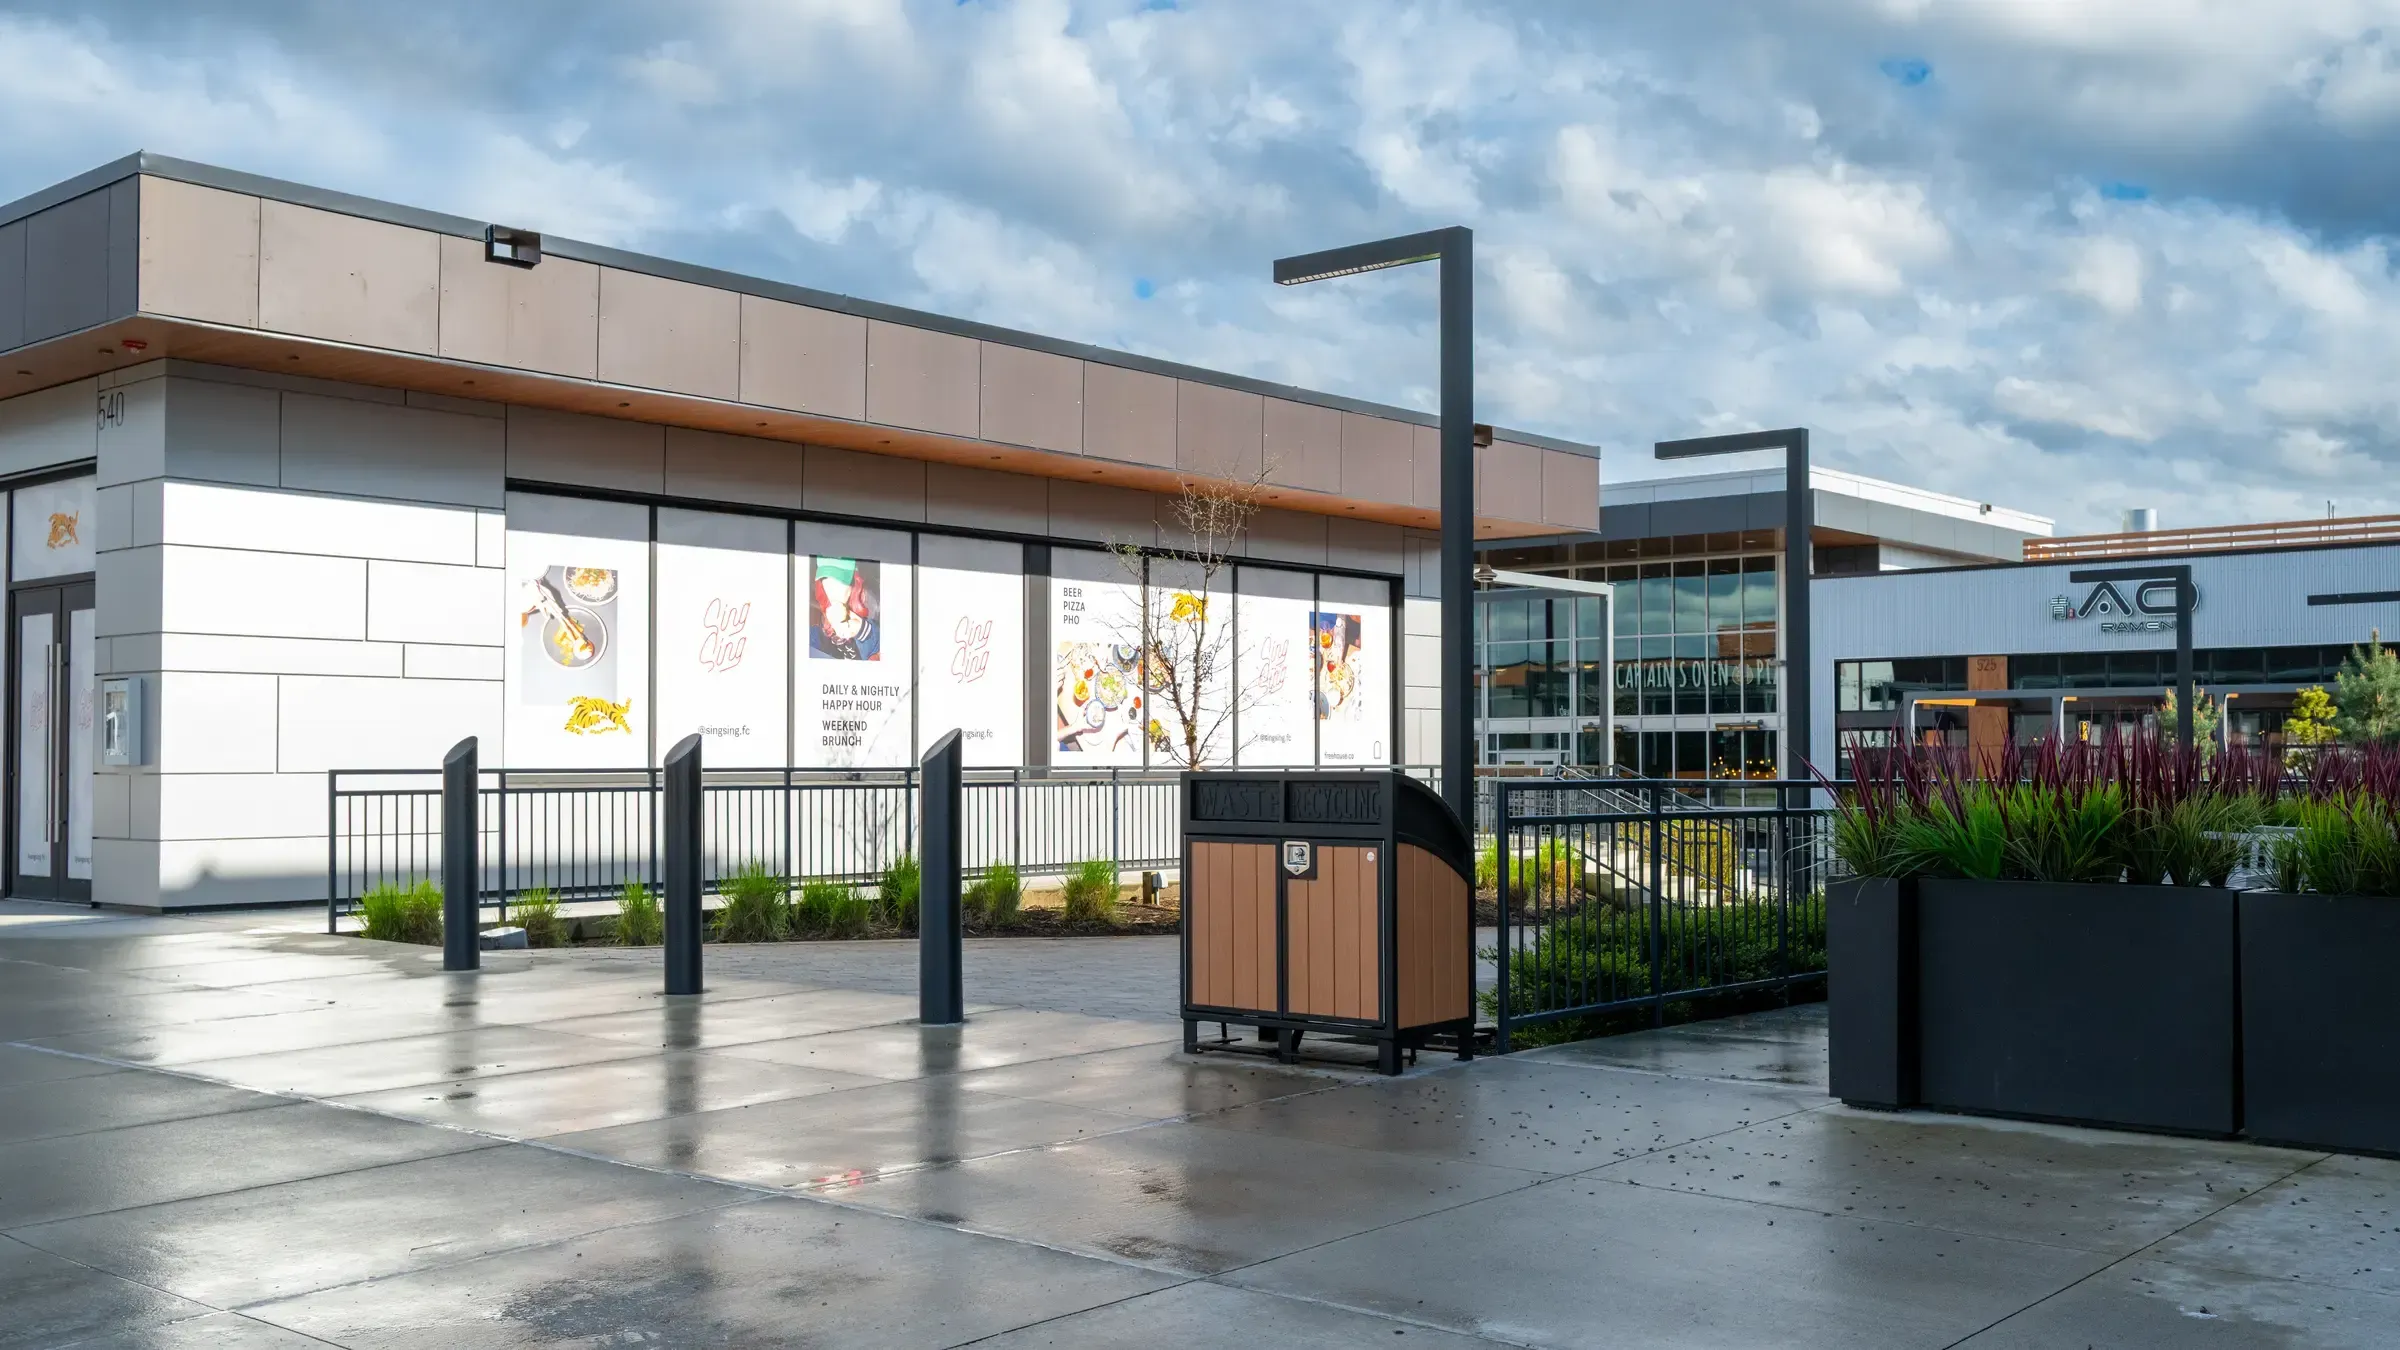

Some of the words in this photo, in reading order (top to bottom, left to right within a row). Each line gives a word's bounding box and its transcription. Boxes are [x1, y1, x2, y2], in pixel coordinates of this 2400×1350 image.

[98, 392, 124, 431] 540
[1063, 587, 1082, 597] BEER
[1063, 600, 1085, 611] PIZZA
[703, 597, 750, 637] Sing
[1063, 614, 1080, 624] PHO
[2101, 620, 2177, 632] RAMEN
[954, 616, 992, 650] Sing
[699, 631, 747, 672] Sing
[951, 646, 990, 683] Sing
[1976, 658, 1997, 671] 525
[1692, 660, 1729, 688] OVEN
[822, 684, 849, 695] DAILY
[851, 685, 858, 695] &
[860, 685, 899, 696] NIGHTLY
[822, 699, 853, 710] HAPPY
[856, 700, 882, 711] HOUR
[698, 724, 750, 738] @singsing.fc
[822, 720, 868, 731] WEEKEND
[822, 735, 862, 746] BRUNCH
[1199, 785, 1280, 819] WASTE
[1291, 786, 1382, 821] RECYCLING
